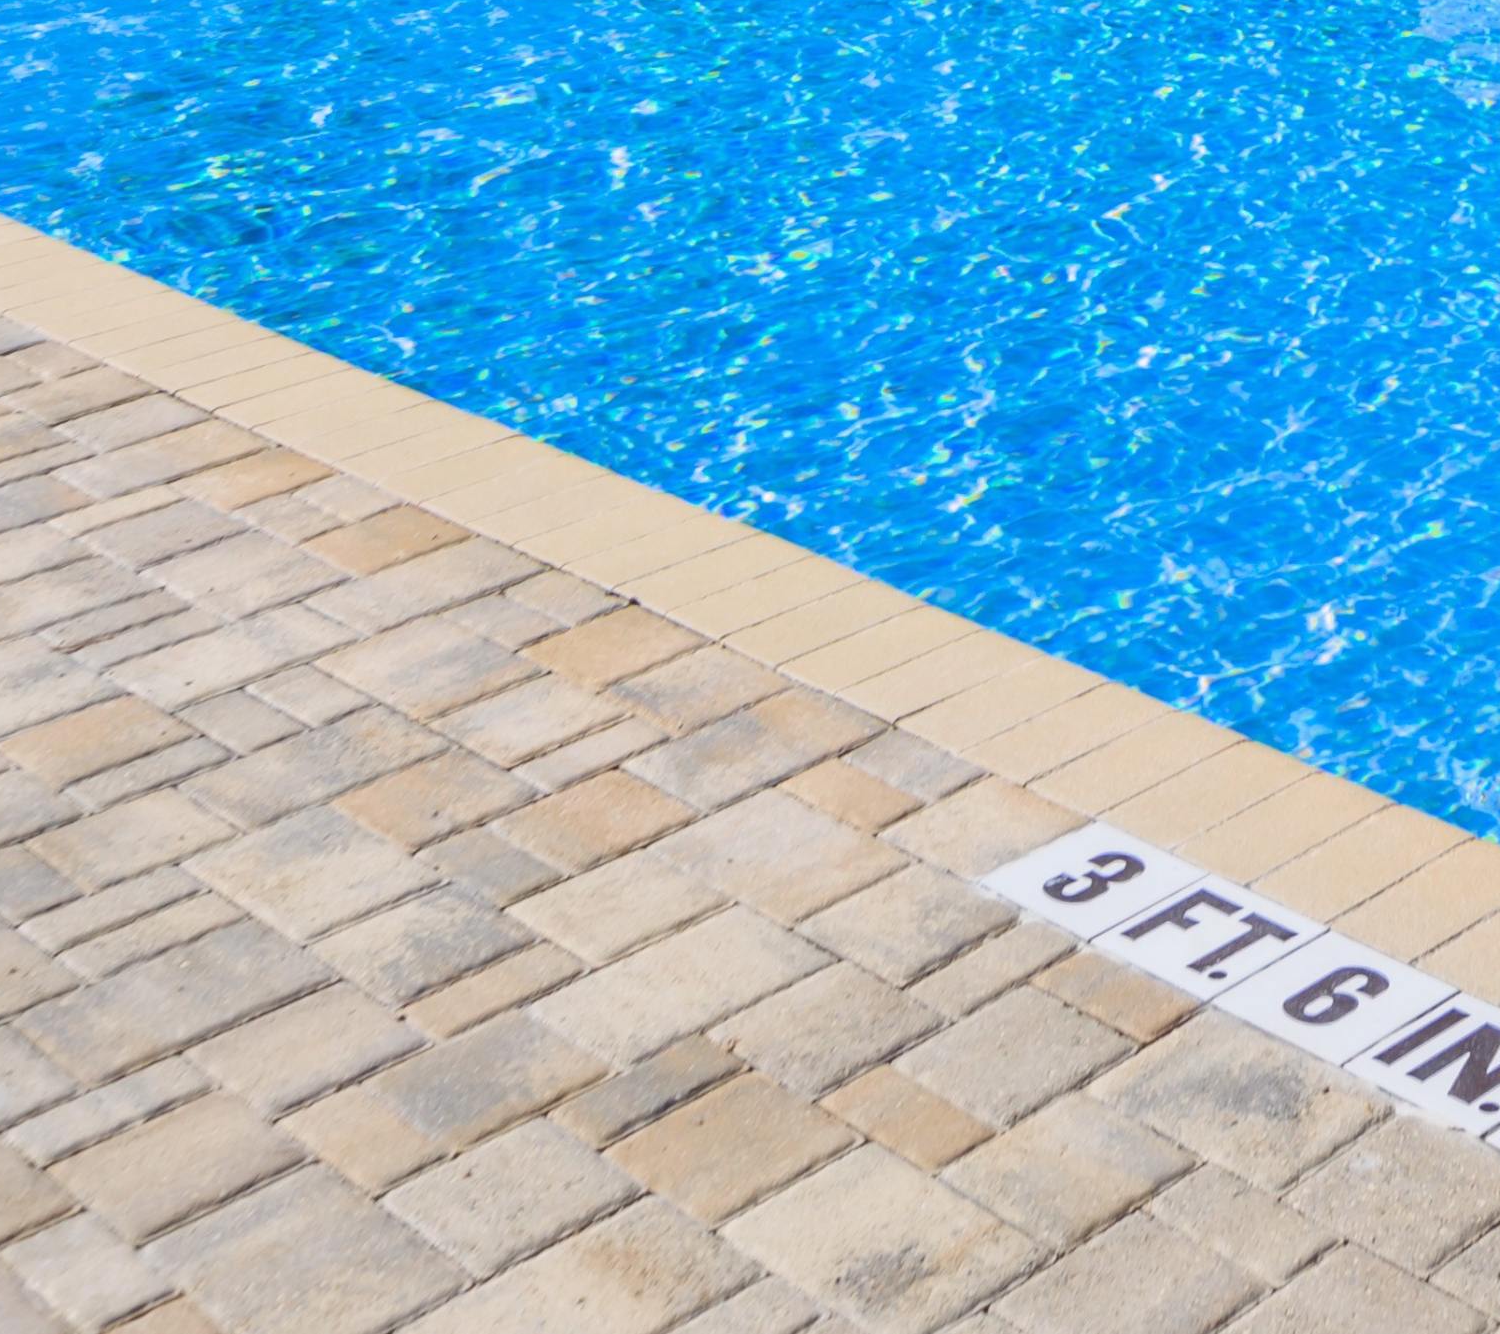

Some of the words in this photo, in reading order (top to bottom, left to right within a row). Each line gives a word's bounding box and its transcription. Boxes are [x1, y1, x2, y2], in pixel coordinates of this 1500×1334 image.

[1042, 851, 1146, 903] 3
[1120, 888, 1300, 979] FT.
[1282, 965, 1390, 1025] 6
